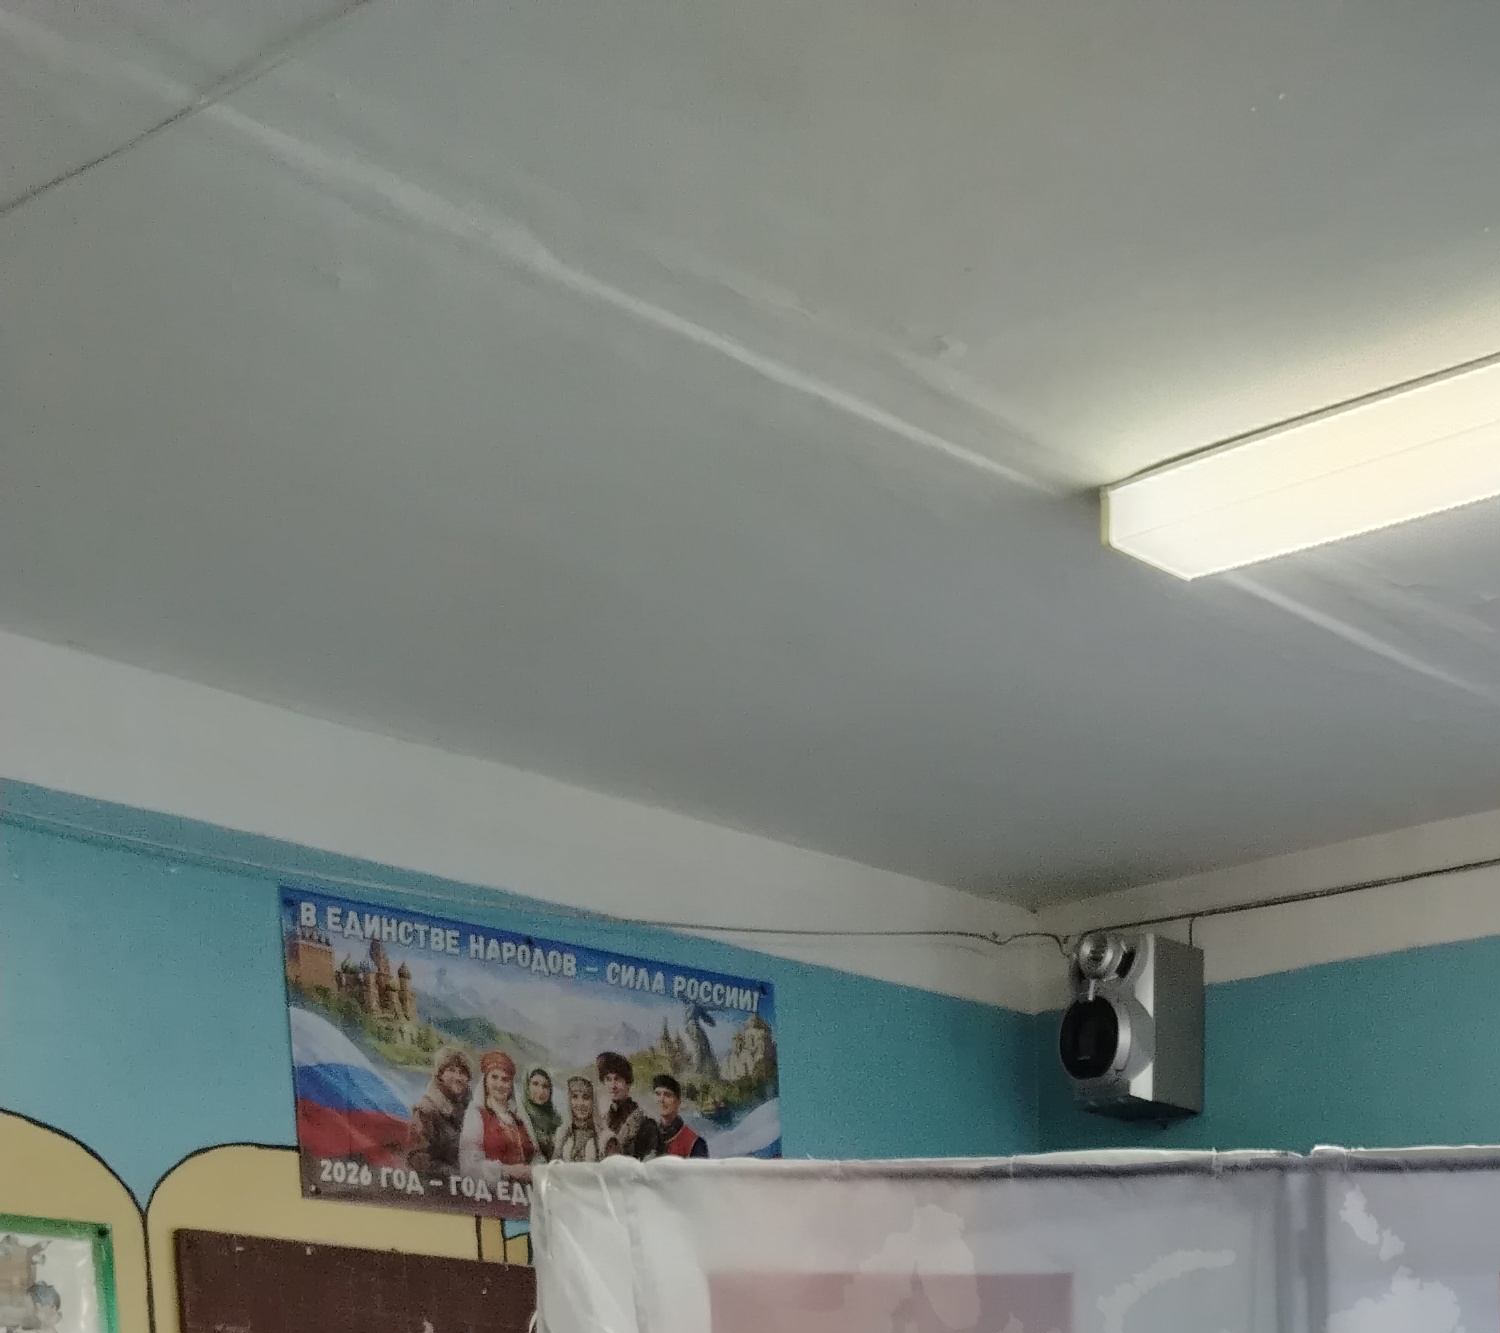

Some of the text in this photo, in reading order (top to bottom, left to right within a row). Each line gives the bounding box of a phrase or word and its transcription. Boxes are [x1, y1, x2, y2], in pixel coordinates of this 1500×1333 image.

[301, 902, 317, 927] В
[327, 906, 460, 956] ЕДИНСТВЕ
[469, 934, 577, 977] НАРОДОВ
[606, 962, 665, 996] СИЛА
[673, 975, 760, 1013] РОССИИ!
[320, 1159, 373, 1186] 2026
[380, 1167, 424, 1195] ГОД
[450, 1175, 493, 1202] ГОД
